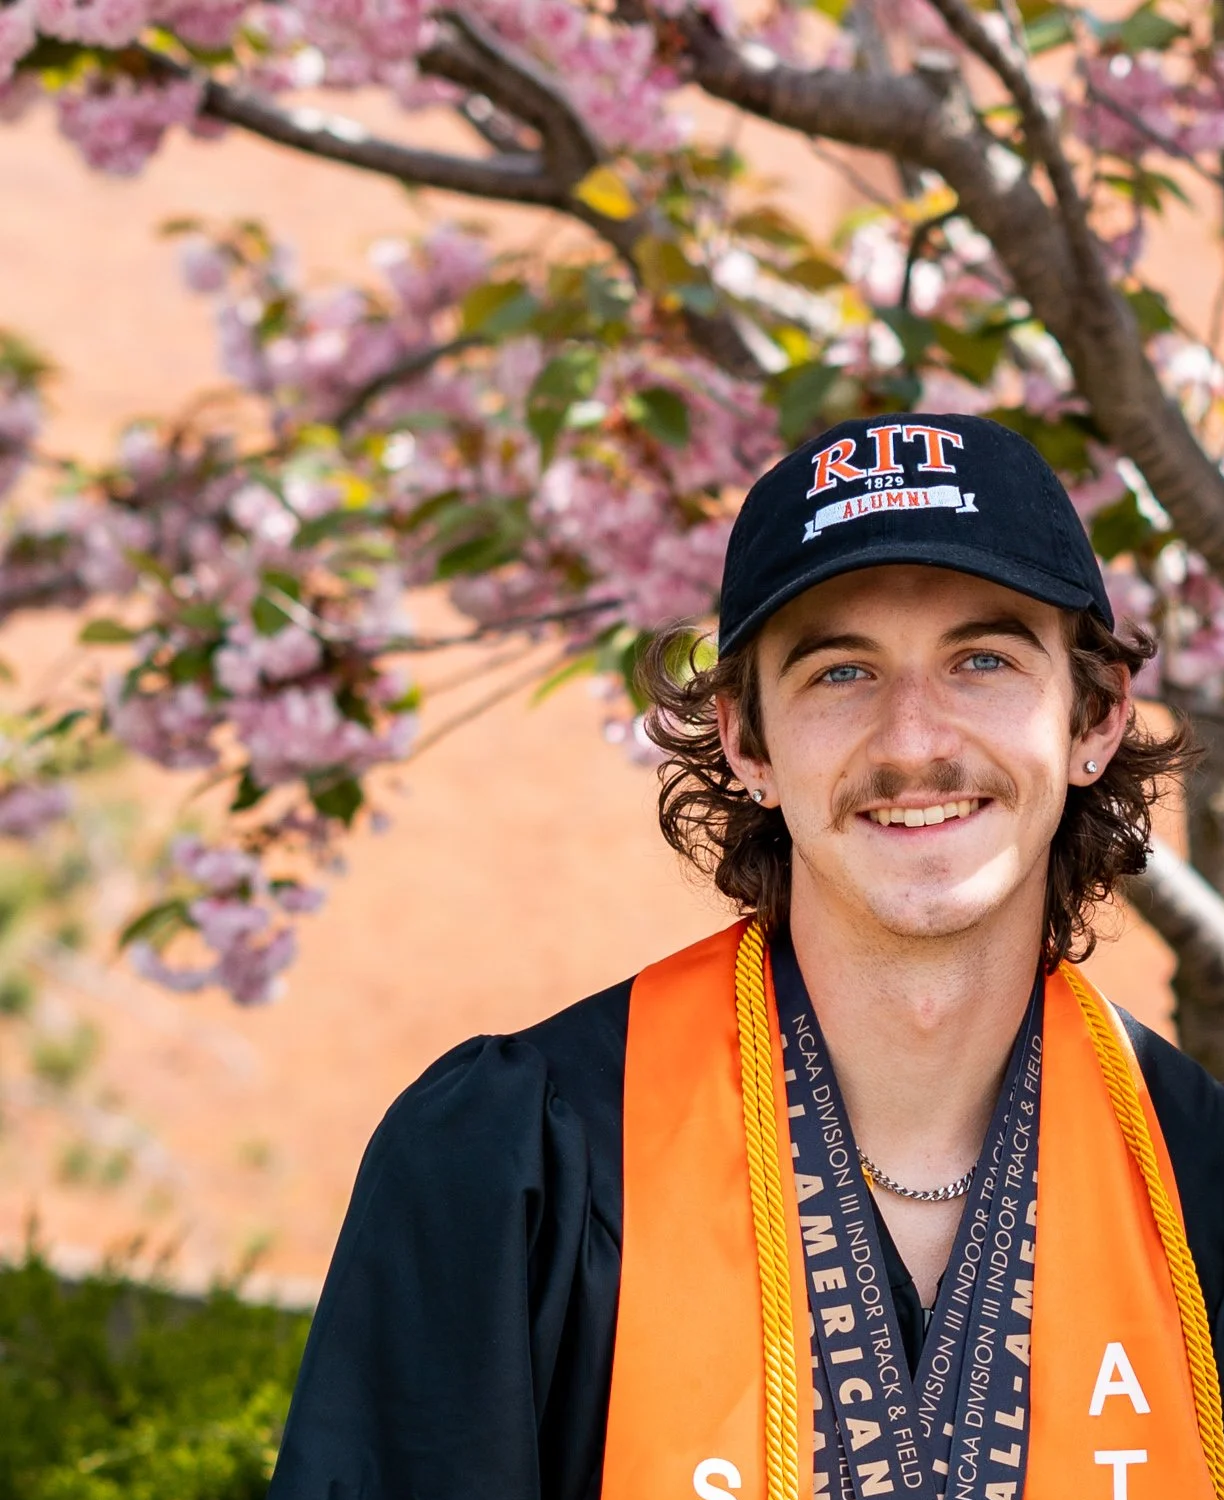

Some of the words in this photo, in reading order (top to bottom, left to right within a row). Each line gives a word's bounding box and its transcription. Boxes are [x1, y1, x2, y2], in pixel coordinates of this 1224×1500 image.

[806, 424, 964, 499] RIT
[864, 475, 905, 490] 1829
[842, 491, 931, 519] ALUMNI
[792, 1013, 823, 1082] NCAA
[1024, 1035, 1043, 1094] FIELD
[812, 1084, 855, 1188] DIVISION
[1020, 1101, 1034, 1116] &
[1004, 1119, 1032, 1189] TRACK
[839, 1193, 861, 1214] III
[846, 1220, 884, 1320] INDOOR
[952, 1208, 989, 1305] INDOOR
[986, 1196, 1019, 1293] INDOOR
[944, 1309, 964, 1331] III
[981, 1298, 1000, 1319] III
[870, 1323, 903, 1398] TRACK
[964, 1324, 997, 1428] DIVISION
[887, 1405, 907, 1421] &
[893, 1427, 923, 1489] FIELD
